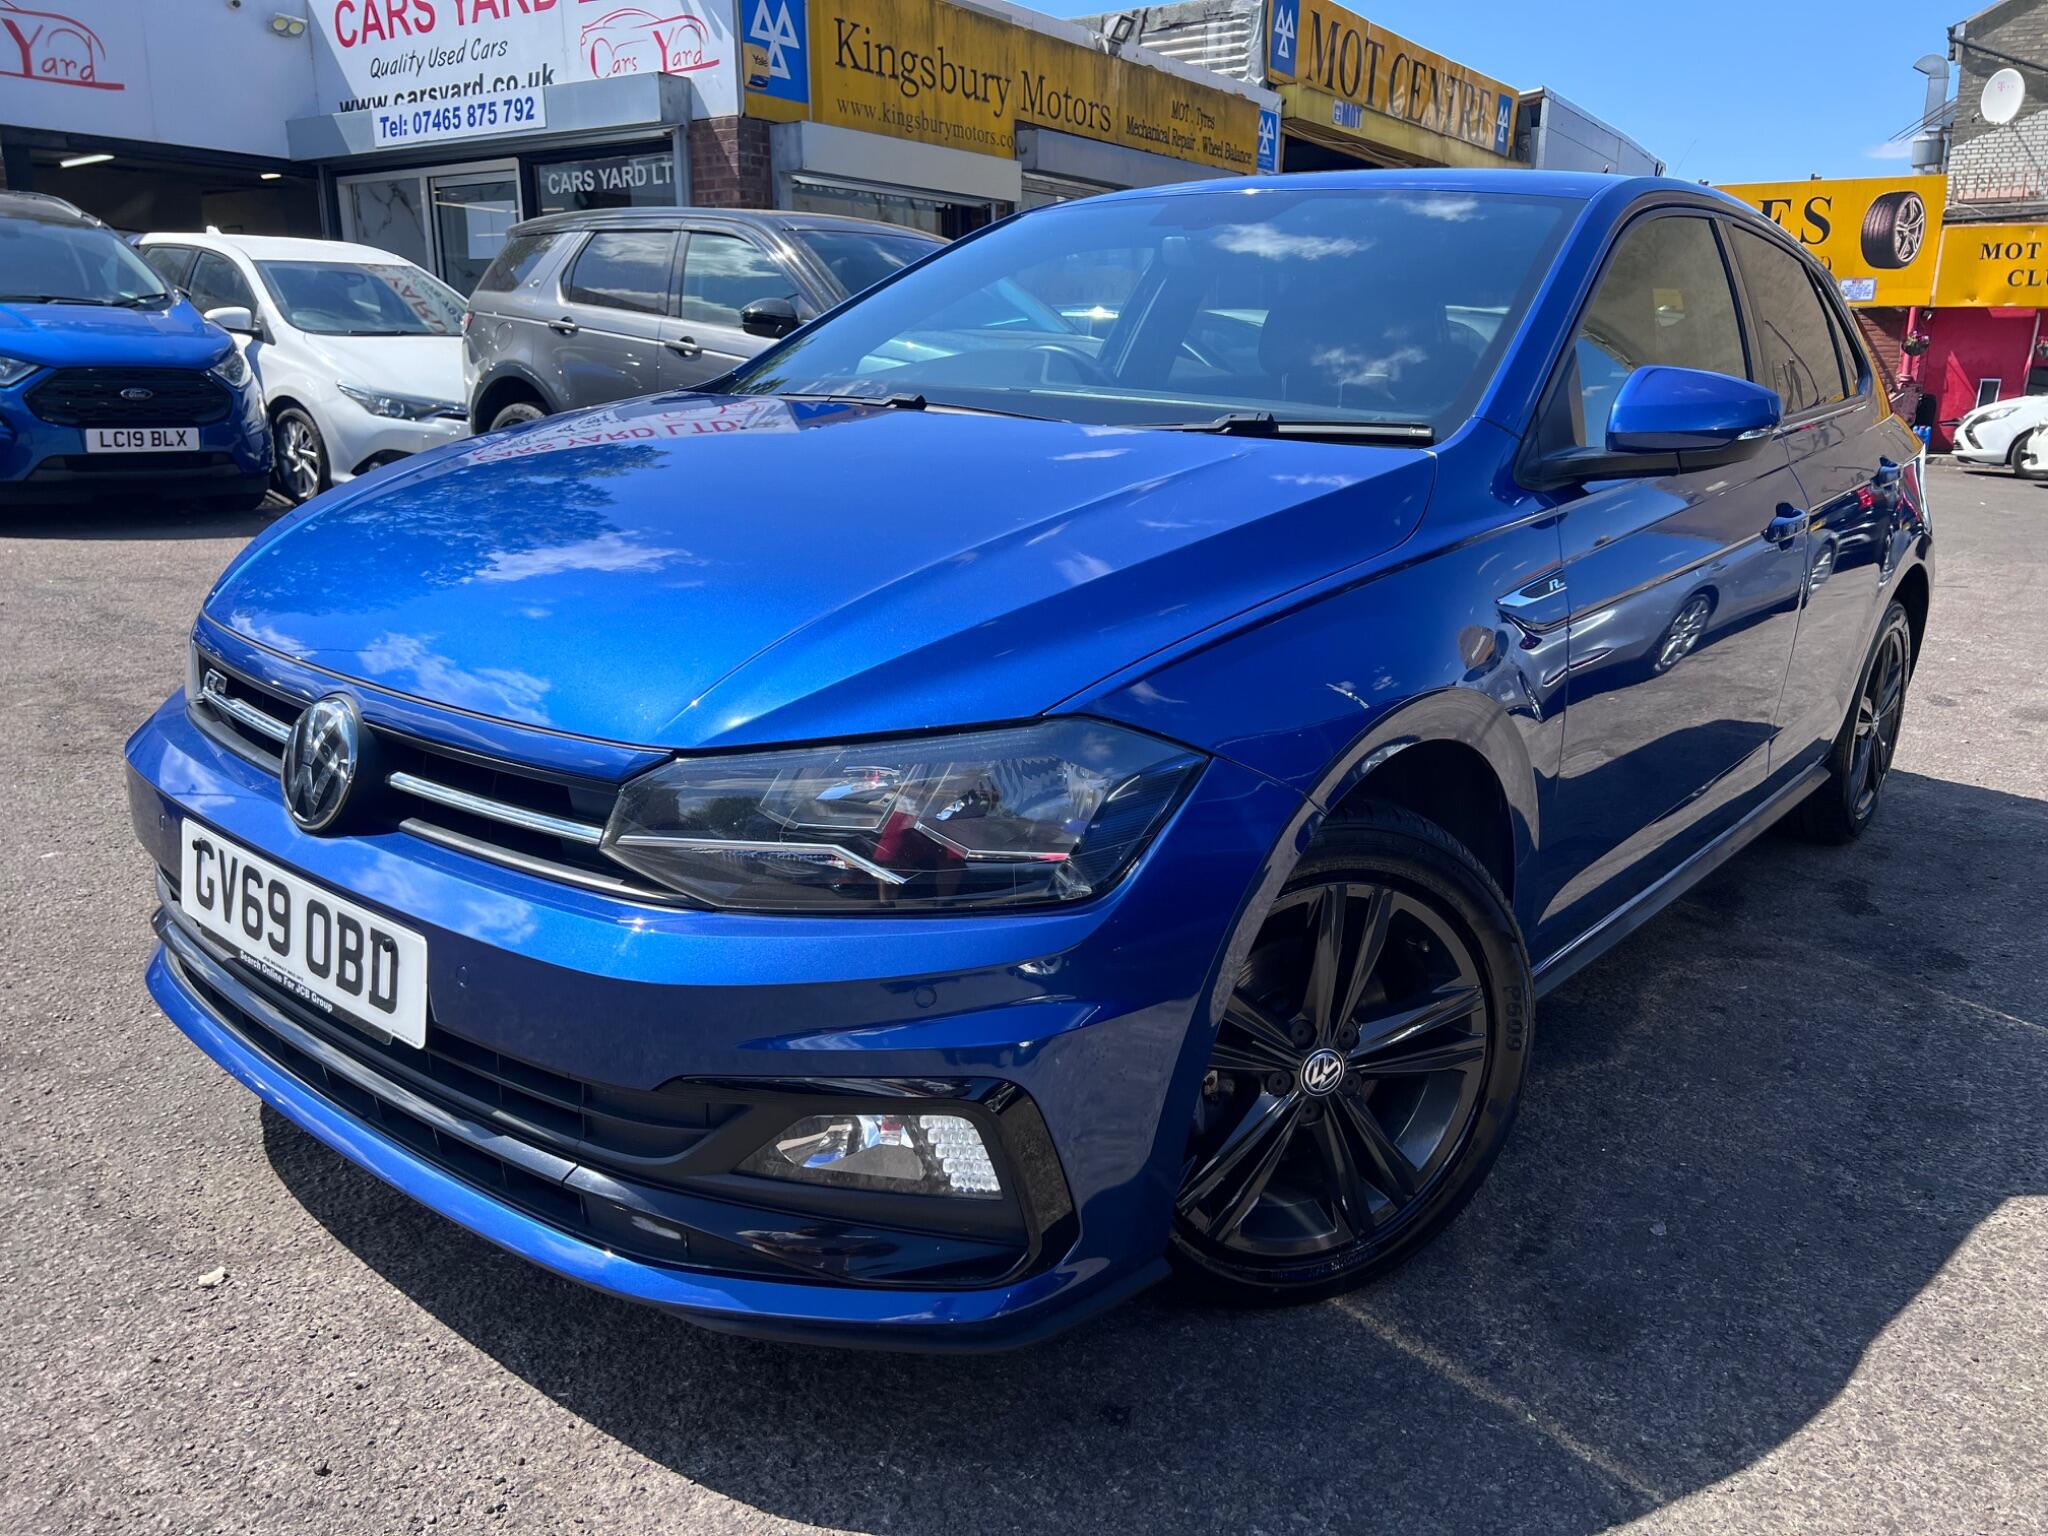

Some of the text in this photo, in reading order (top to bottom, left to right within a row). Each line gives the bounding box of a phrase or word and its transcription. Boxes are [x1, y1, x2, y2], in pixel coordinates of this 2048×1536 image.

[334, 0, 436, 48] CARS
[1, 17, 95, 82] Yard
[370, 37, 508, 78] Quality Used Cars
[834, 17, 1111, 133] Kingsbury Motors
[1305, 10, 1492, 146] MOT CENTRE
[380, 96, 535, 138] Tel: 07465 875 792
[1171, 100, 1190, 122] MOT
[1126, 115, 1170, 145] Mechanical
[1171, 128, 1196, 153] Repair
[1202, 136, 1223, 159] Wheel
[1224, 142, 1252, 165] Balance
[548, 170, 595, 194] CARS
[598, 164, 647, 189] YARD
[1979, 242, 2042, 260] MOT
[2007, 268, 2048, 287] CL
[100, 429, 188, 448] LC19 BLX
[193, 837, 399, 1015] GV69 OBD
[240, 949, 261, 970] Search
[261, 966, 282, 984] Online
[283, 976, 296, 991] For
[295, 984, 311, 999] JCB
[311, 992, 333, 1014] Group
